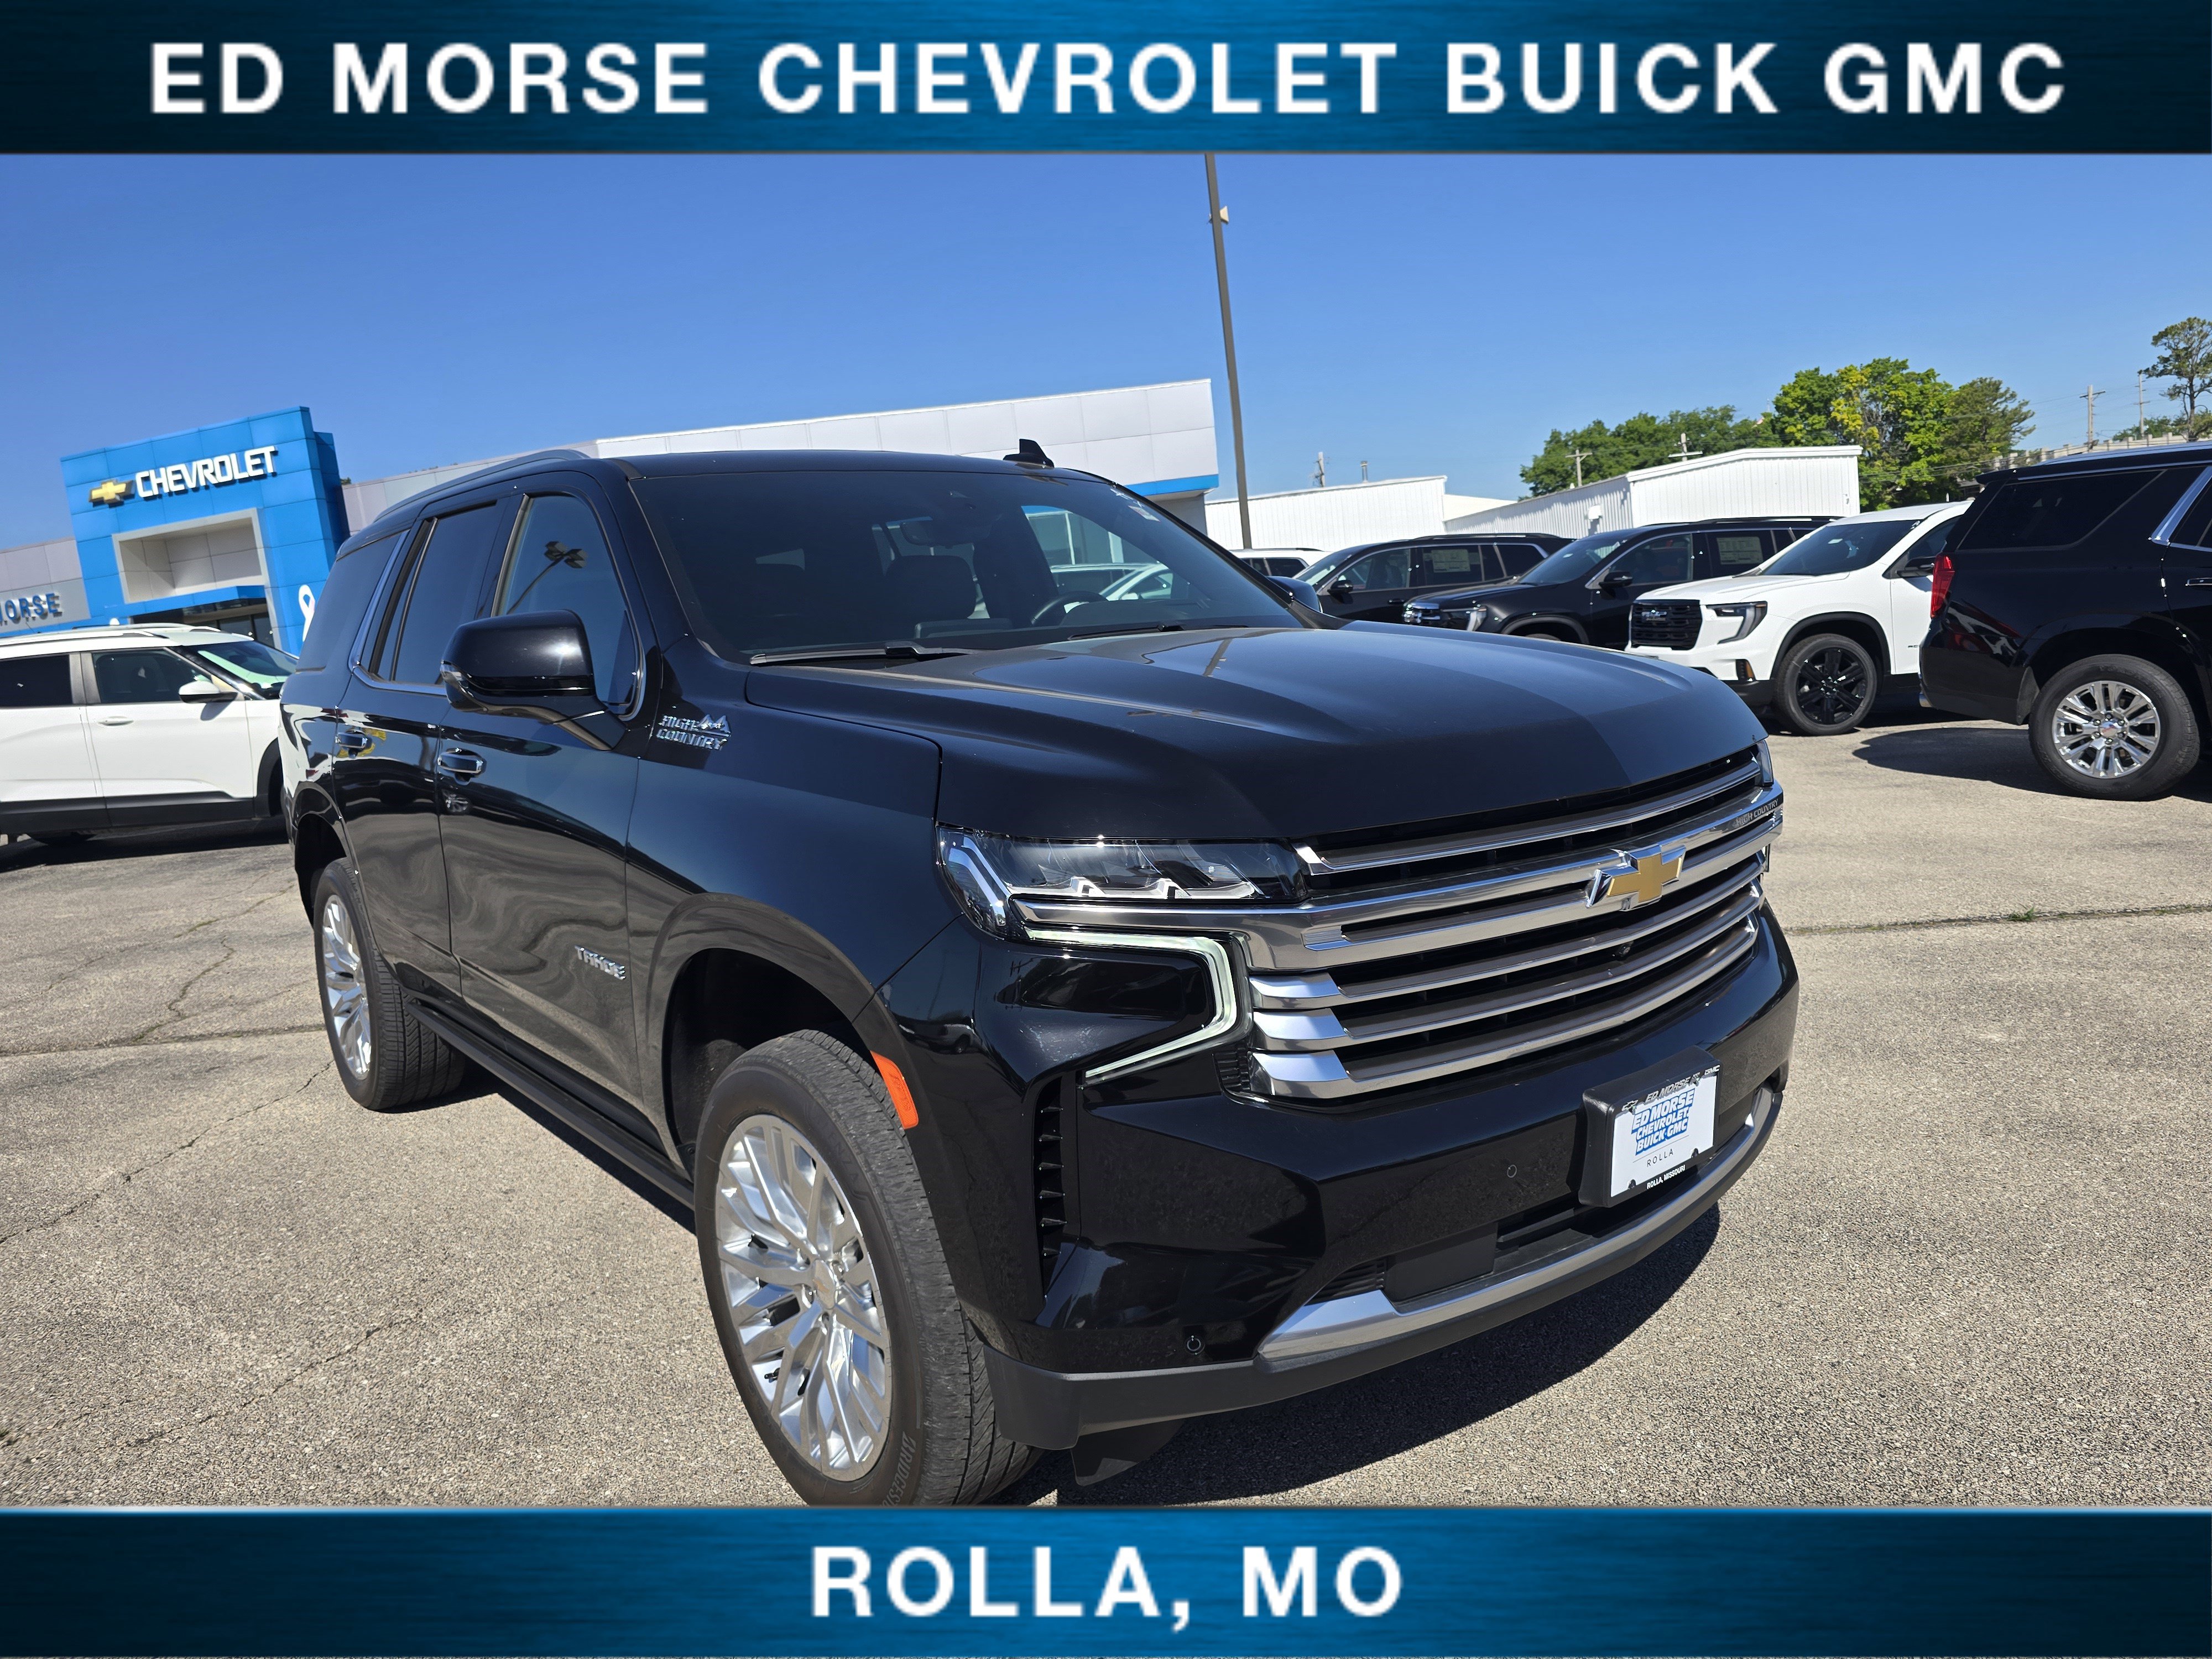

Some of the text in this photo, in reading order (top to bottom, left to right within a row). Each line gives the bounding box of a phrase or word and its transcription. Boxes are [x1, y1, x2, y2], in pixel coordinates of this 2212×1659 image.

[135, 445, 276, 498] CHEVROLET
[656, 728, 728, 751] COUNTRY
[1734, 798, 1778, 827] HIGH COUNTRY
[575, 945, 626, 980] TAHOE
[1704, 1065, 1720, 1075] GMC
[1645, 1076, 1691, 1103] ED MORSE
[1632, 1088, 1694, 1131] ED MORSE
[1636, 1107, 1690, 1140] CHEVROLET
[1636, 1118, 1689, 1152] BUICK GMC
[1647, 1148, 1673, 1167] ROLLA
[1646, 1164, 1686, 1190] ROLLA, MISSOURI
